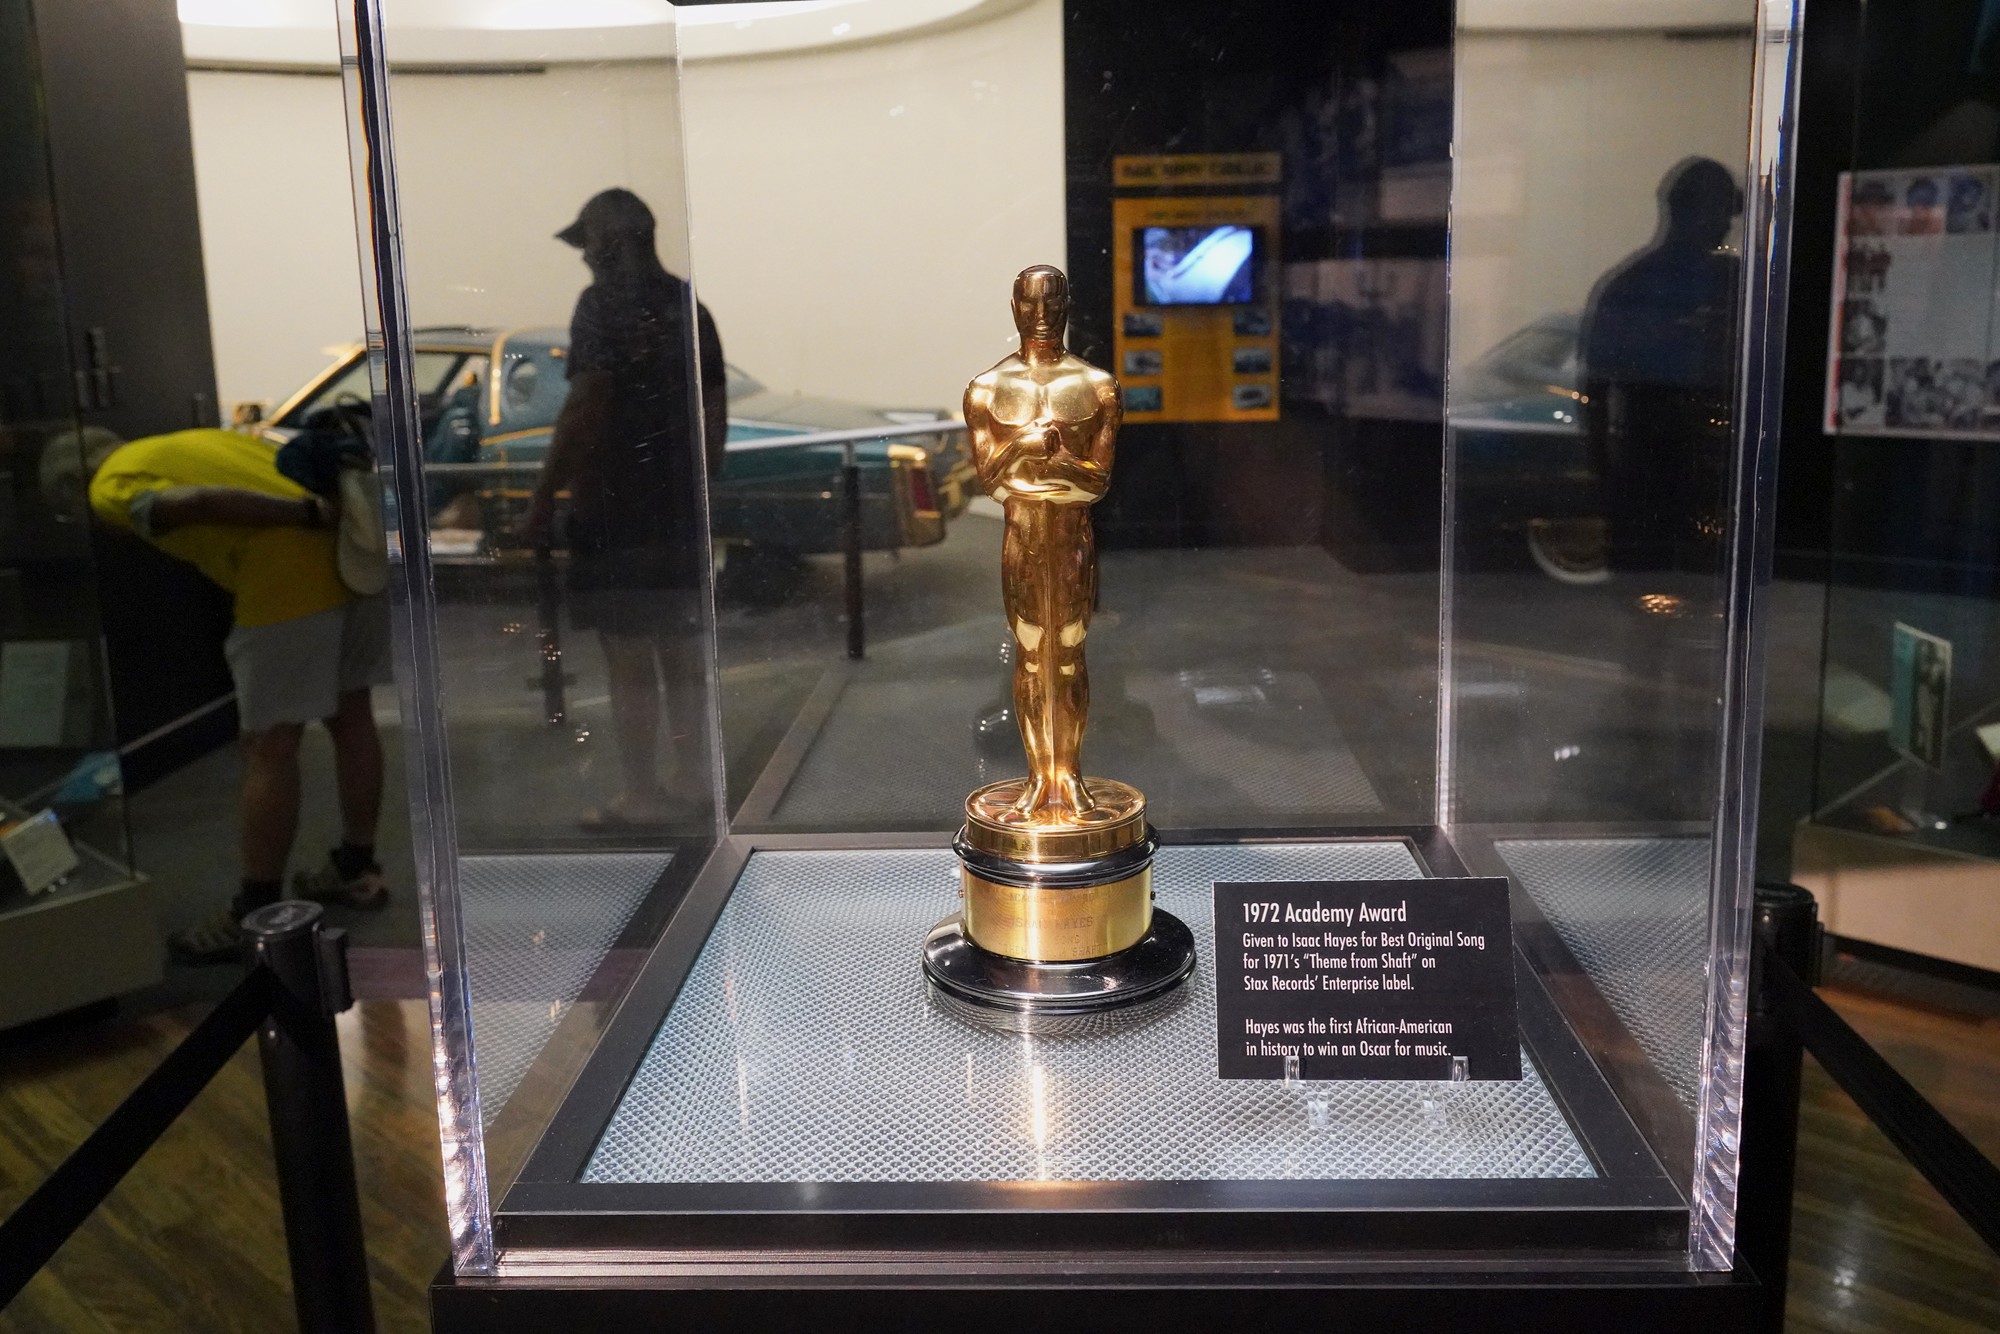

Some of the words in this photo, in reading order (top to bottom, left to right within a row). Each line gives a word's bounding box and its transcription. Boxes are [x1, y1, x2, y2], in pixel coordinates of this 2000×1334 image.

[1243, 902, 1280, 923] 1972
[1284, 900, 1355, 928] Academy
[1358, 900, 1407, 922] Award
[1242, 932, 1275, 948] Given
[1277, 934, 1289, 948] to
[1292, 932, 1321, 948] Isaac
[1323, 932, 1358, 951] Hayes
[1360, 930, 1378, 947] for
[1380, 931, 1405, 947] Best
[1407, 930, 1454, 951] Original
[1456, 931, 1485, 951] Song
[1242, 952, 1260, 969] for
[1350, 952, 1378, 969] from
[1421, 957, 1436, 969] on
[1244, 975, 1269, 991] Stax
[1322, 974, 1380, 994] Enterprise
[1382, 973, 1415, 991] label.
[1245, 1018, 1280, 1038] Hayes
[1282, 1022, 1305, 1034] was
[1307, 1017, 1326, 1034] the
[1329, 1017, 1353, 1034] first
[1355, 1017, 1453, 1034] African-American
[1245, 1041, 1257, 1056] in
[1260, 1039, 1300, 1057] history
[1302, 1042, 1315, 1056] to
[1317, 1041, 1338, 1056] win
[1341, 1045, 1357, 1056] an
[1359, 1040, 1391, 1056] Oscar
[1394, 1039, 1412, 1056] for
[1414, 1041, 1452, 1056] music.
